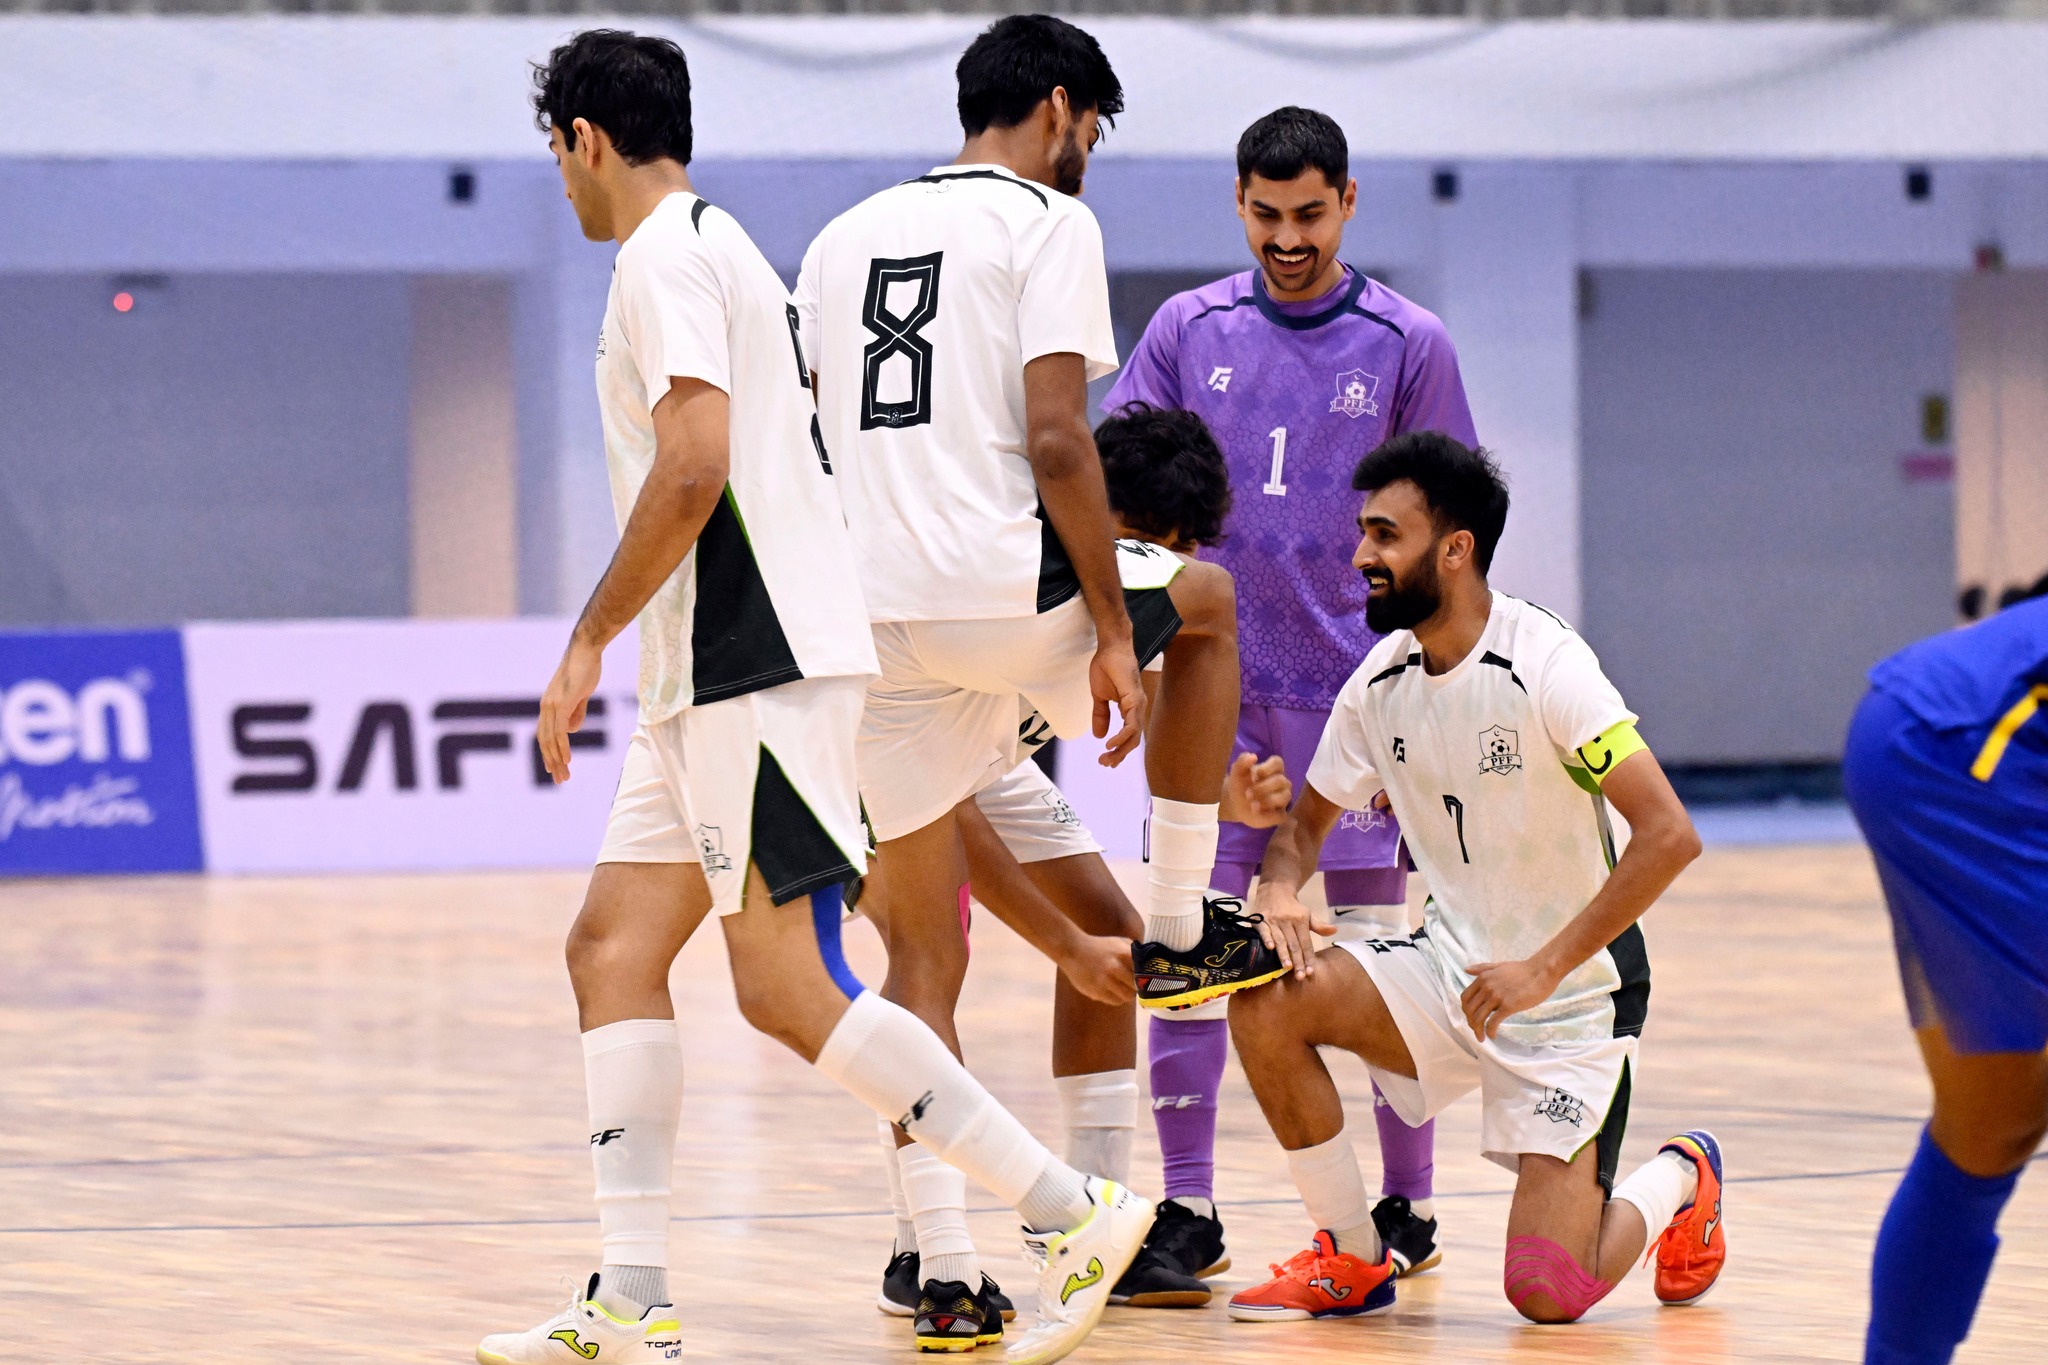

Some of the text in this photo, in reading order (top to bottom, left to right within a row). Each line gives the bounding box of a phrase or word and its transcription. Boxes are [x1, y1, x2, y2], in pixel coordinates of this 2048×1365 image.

[860, 251, 944, 431] 8
[1344, 399, 1366, 408] PFF
[1263, 427, 1287, 496] 1
[0, 677, 151, 766] en
[229, 696, 607, 793] SAFF
[1491, 756, 1513, 766] PFF
[1354, 813, 1374, 822] PFF
[1442, 795, 1470, 864] 7
[1548, 1103, 1571, 1115] PFF
